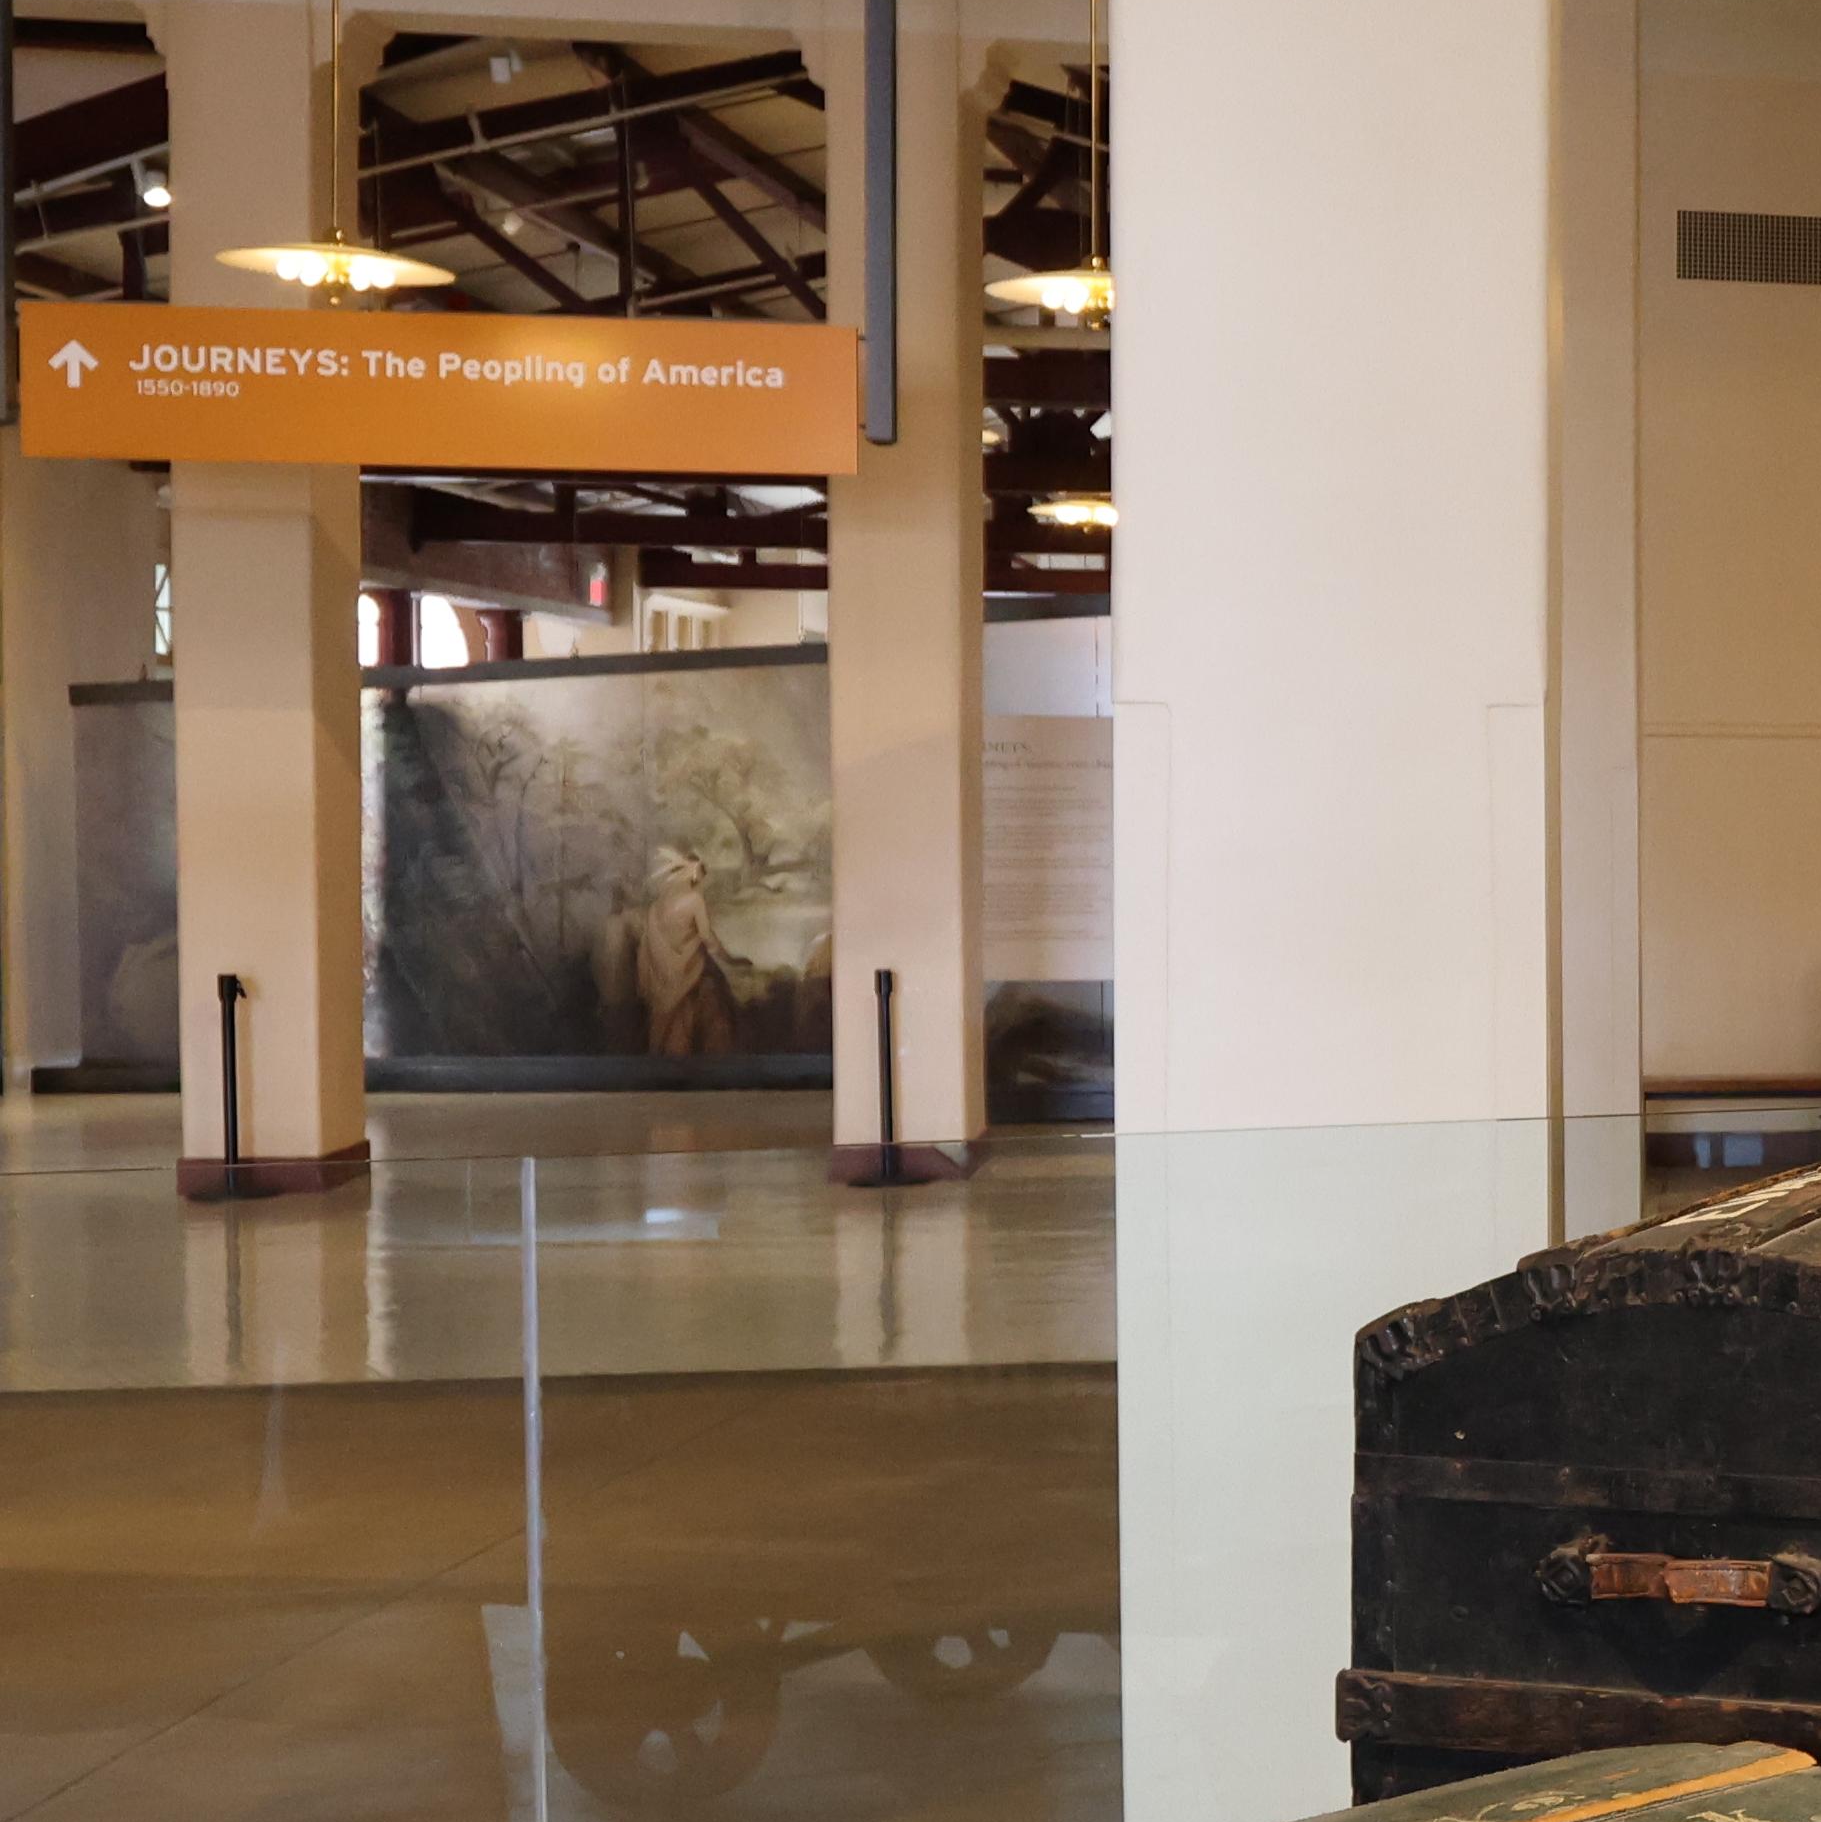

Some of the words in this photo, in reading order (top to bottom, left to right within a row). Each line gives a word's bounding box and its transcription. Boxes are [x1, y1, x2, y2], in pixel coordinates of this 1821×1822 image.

[129, 343, 349, 377] JOURNEYS:
[362, 349, 426, 378] The
[438, 352, 587, 388] Peopling
[598, 357, 630, 384] of
[643, 358, 784, 389] America
[136, 379, 240, 397] 1550-1890
